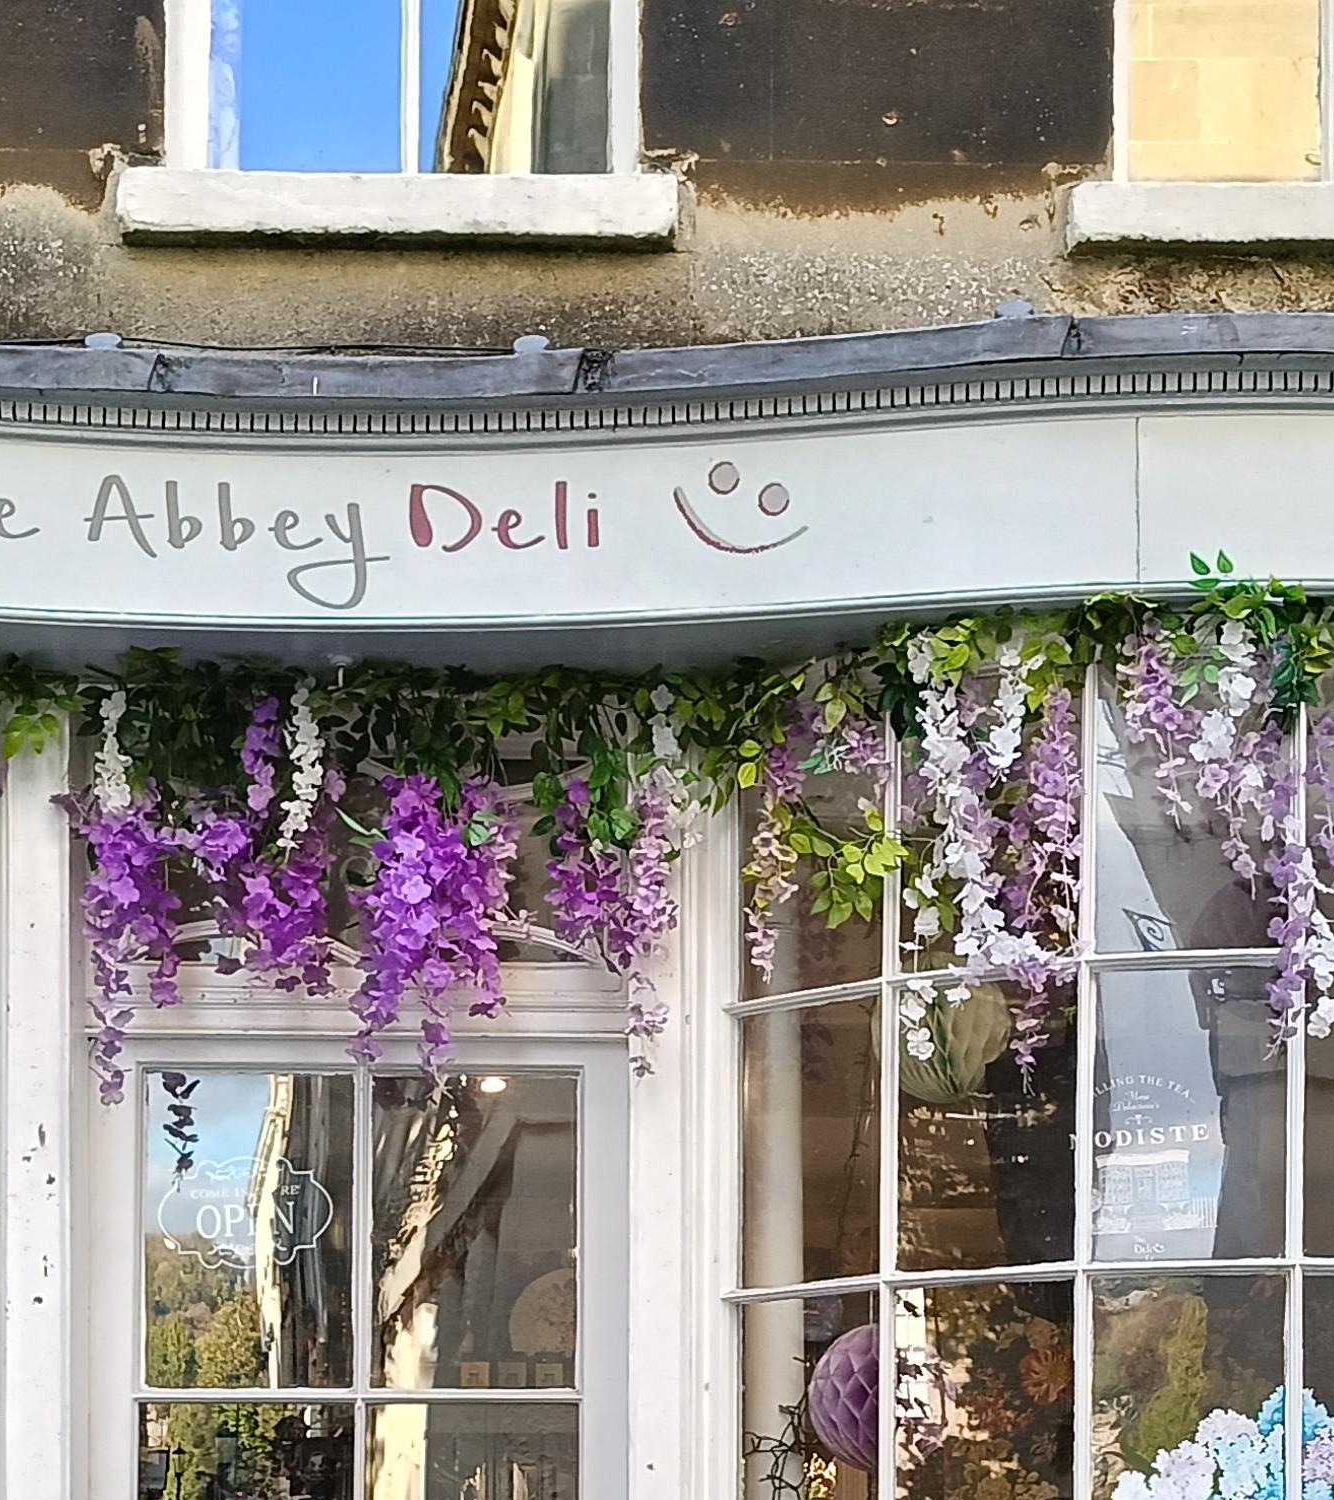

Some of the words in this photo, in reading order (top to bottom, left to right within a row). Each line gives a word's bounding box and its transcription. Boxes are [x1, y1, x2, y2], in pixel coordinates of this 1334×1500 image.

[84, 473, 391, 611] Abbey
[408, 478, 602, 553] Deli
[1138, 1074, 1164, 1087] THE
[1167, 1080, 1191, 1099] TEA
[190, 1187, 230, 1200] COME
